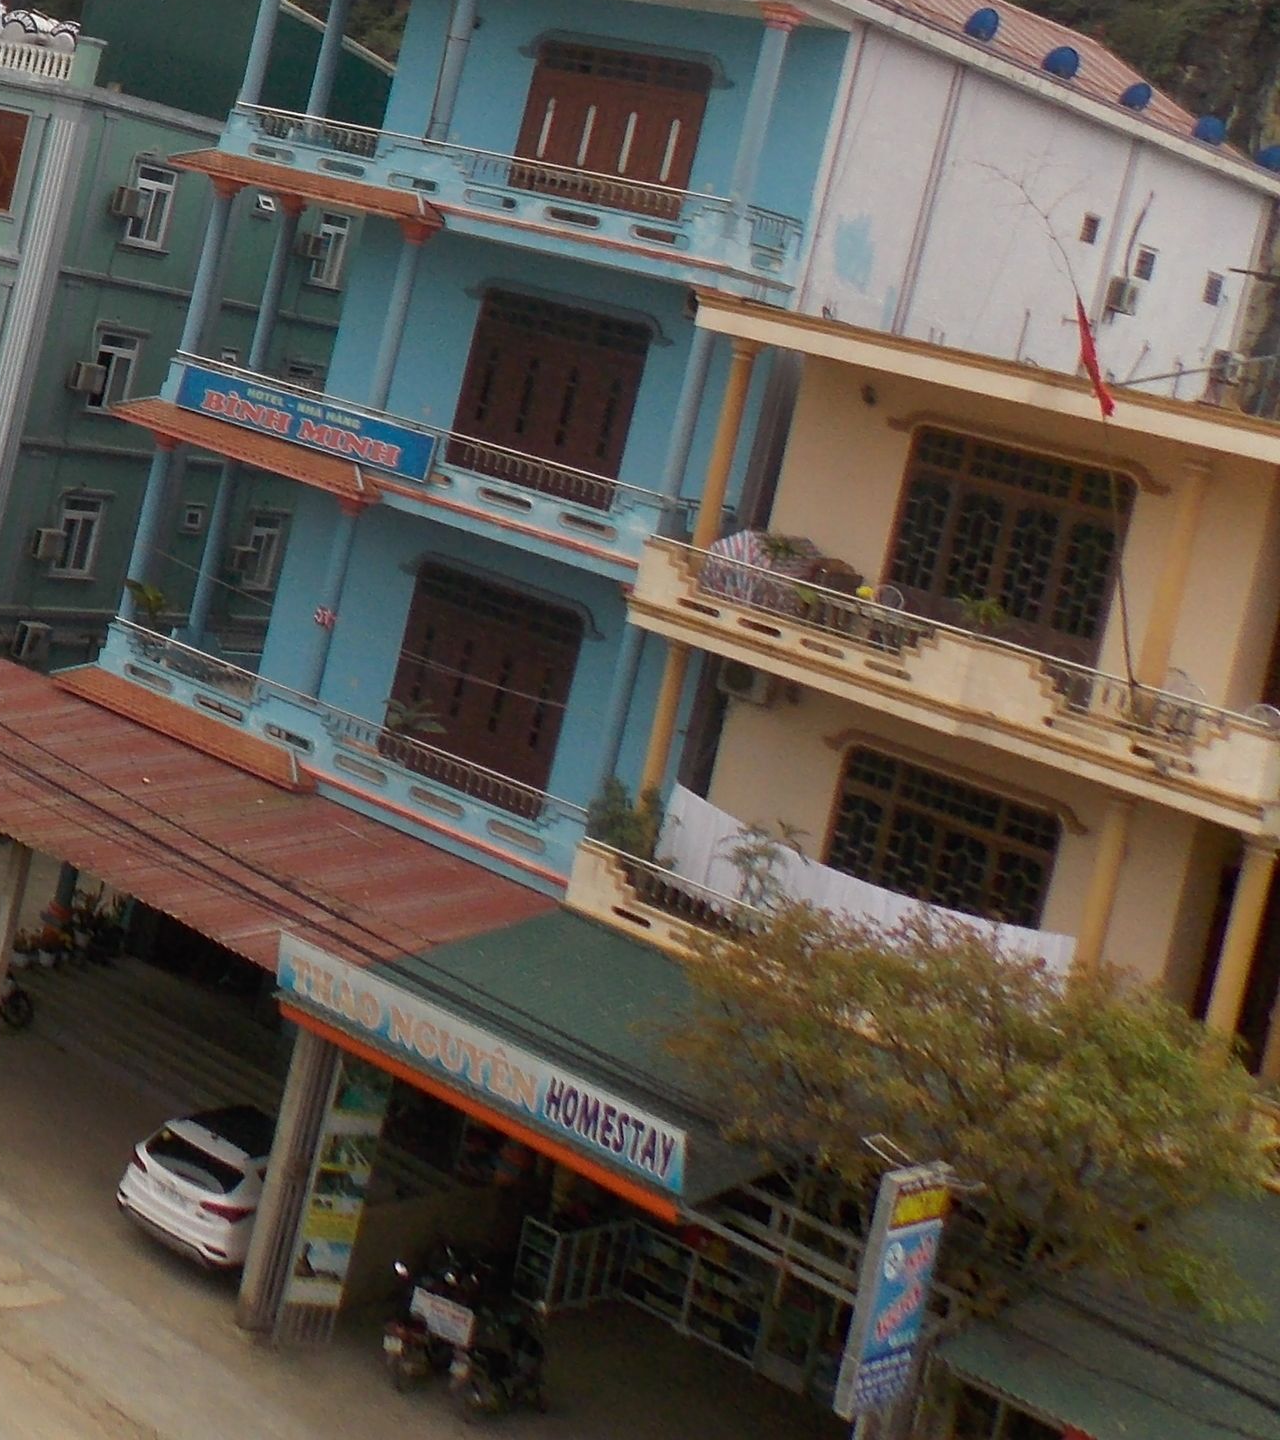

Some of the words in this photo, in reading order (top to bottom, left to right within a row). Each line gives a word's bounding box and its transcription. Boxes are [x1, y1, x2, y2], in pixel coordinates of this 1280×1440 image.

[201, 389, 293, 434] BÌNH
[296, 417, 404, 468] MINH
[388, 1005, 539, 1113] NGUYÊN
[543, 1076, 676, 1180] HOMESTAY
